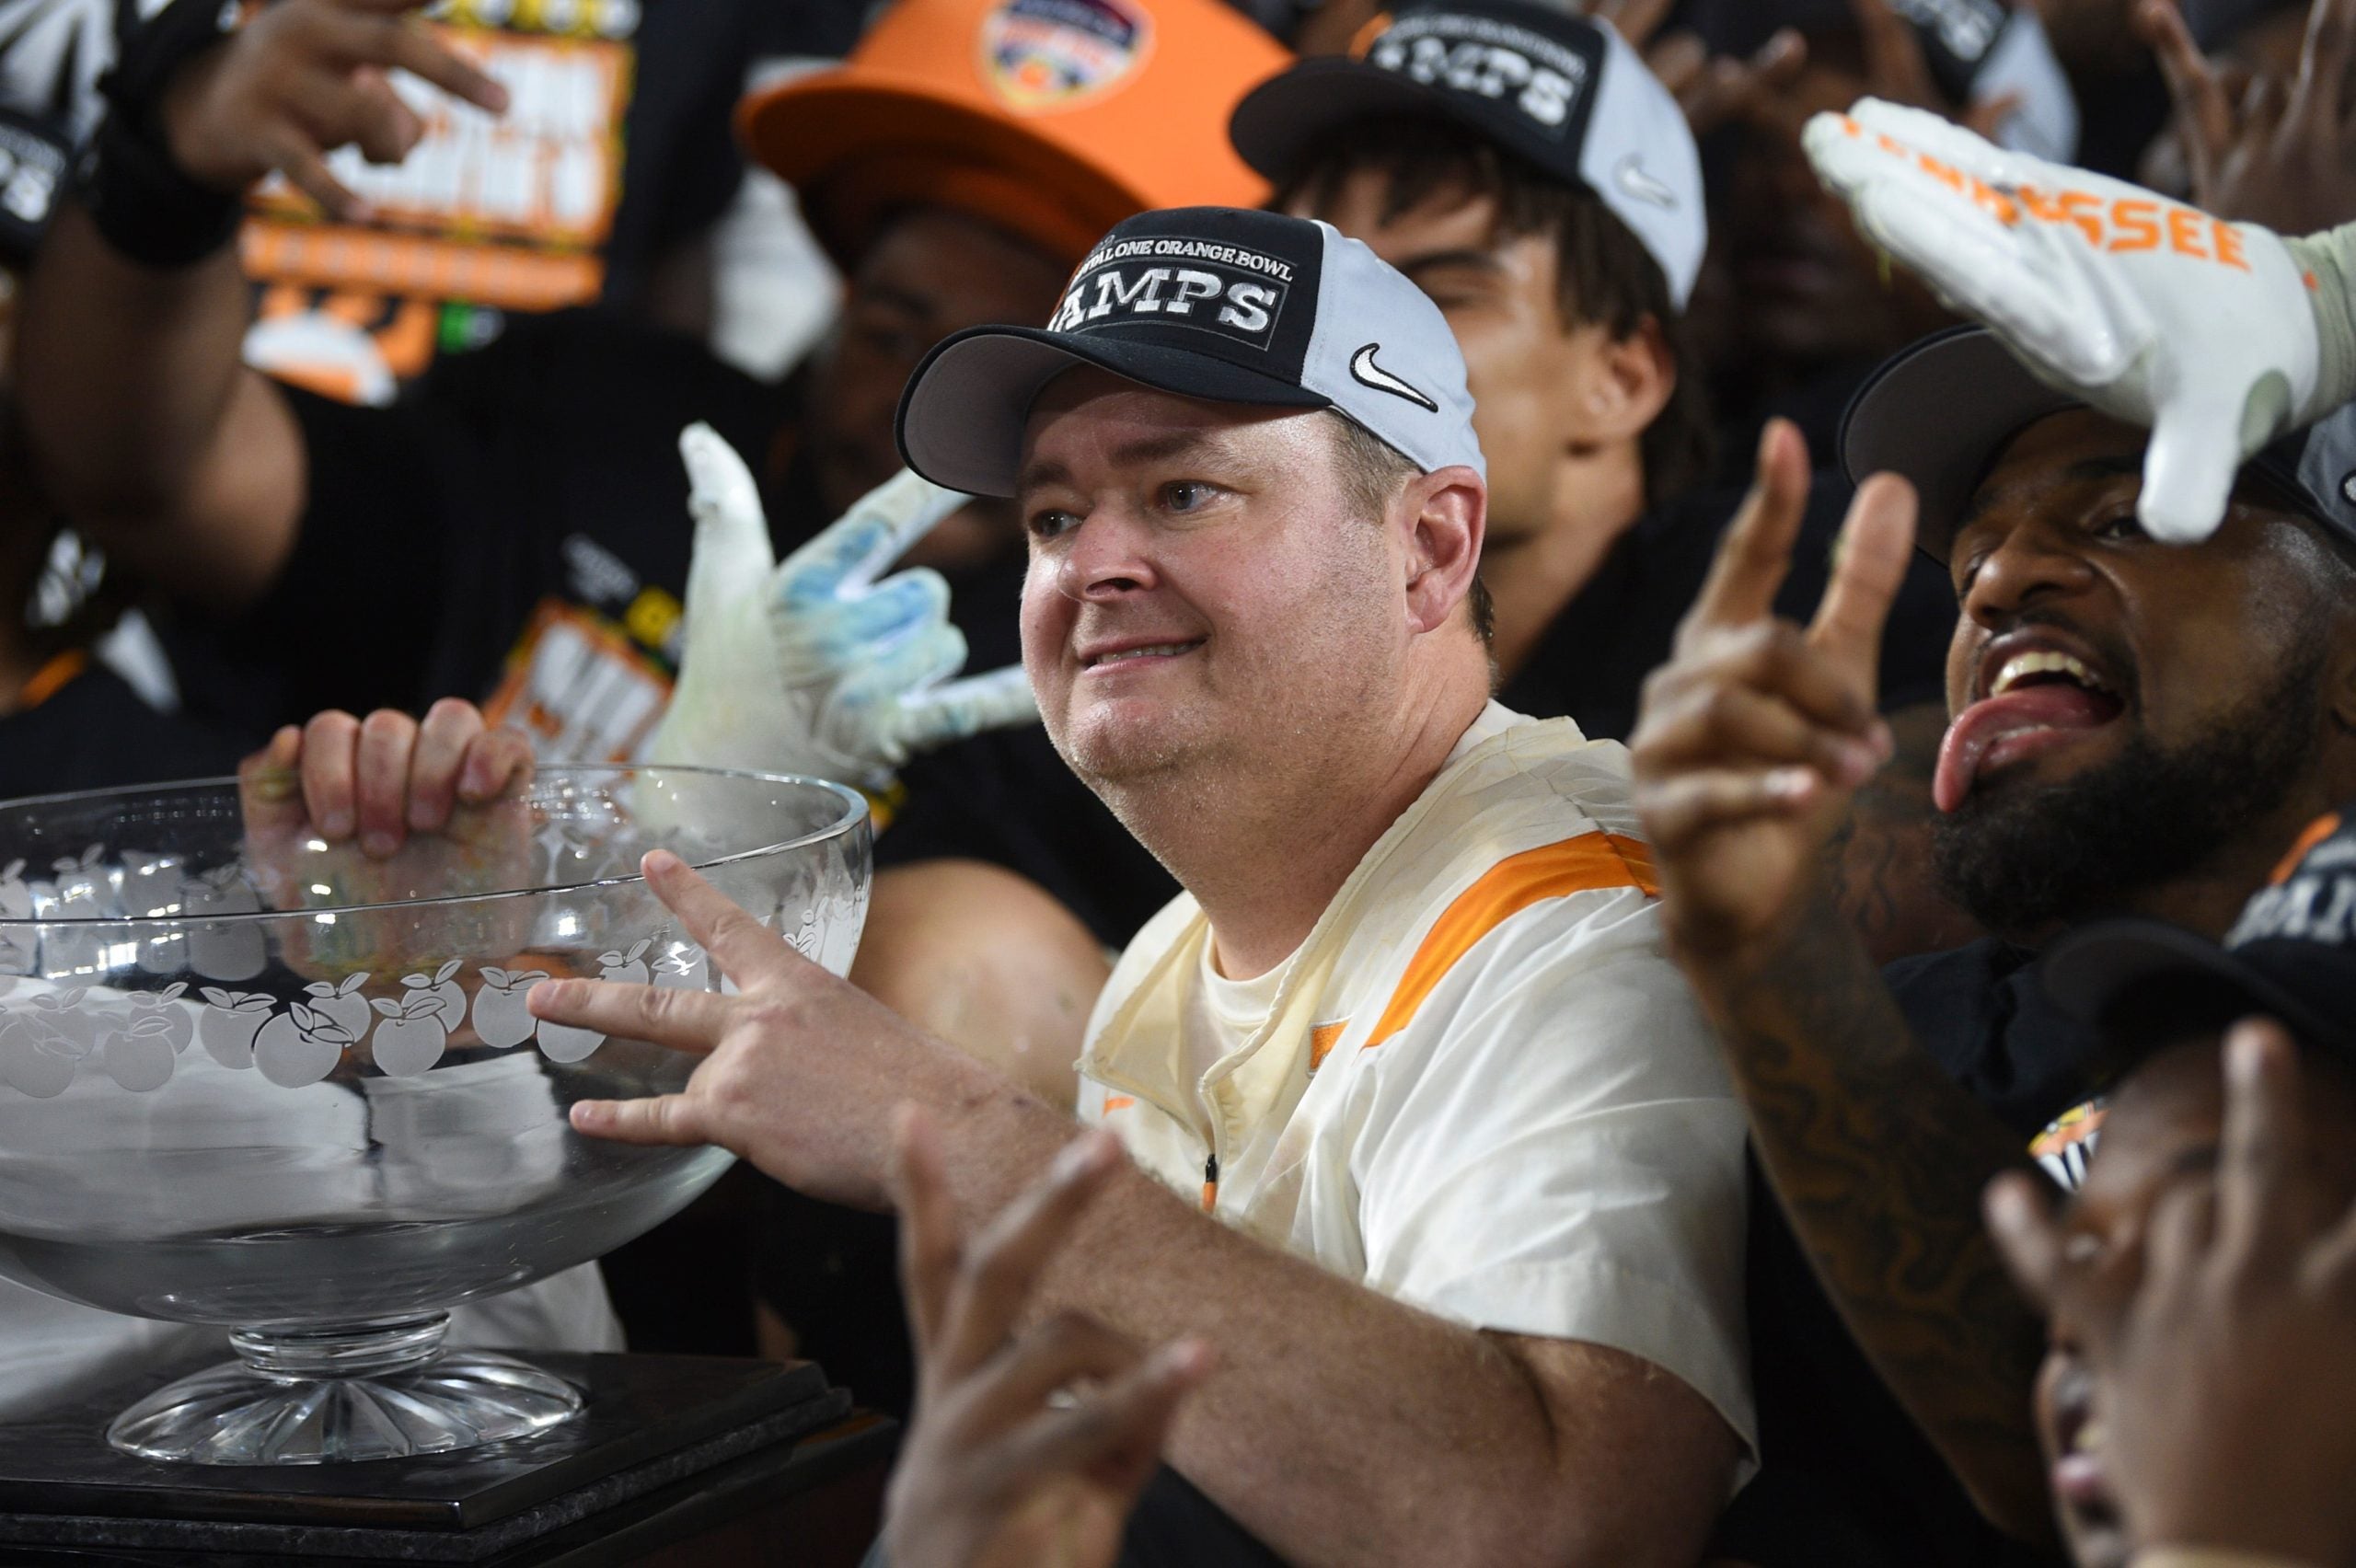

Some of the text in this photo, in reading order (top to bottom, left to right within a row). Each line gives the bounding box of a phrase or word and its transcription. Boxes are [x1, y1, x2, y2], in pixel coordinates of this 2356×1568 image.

[1114, 239, 1155, 258] ONE
[1154, 239, 1236, 264] ORANGE
[1234, 254, 1293, 282] BOWL
